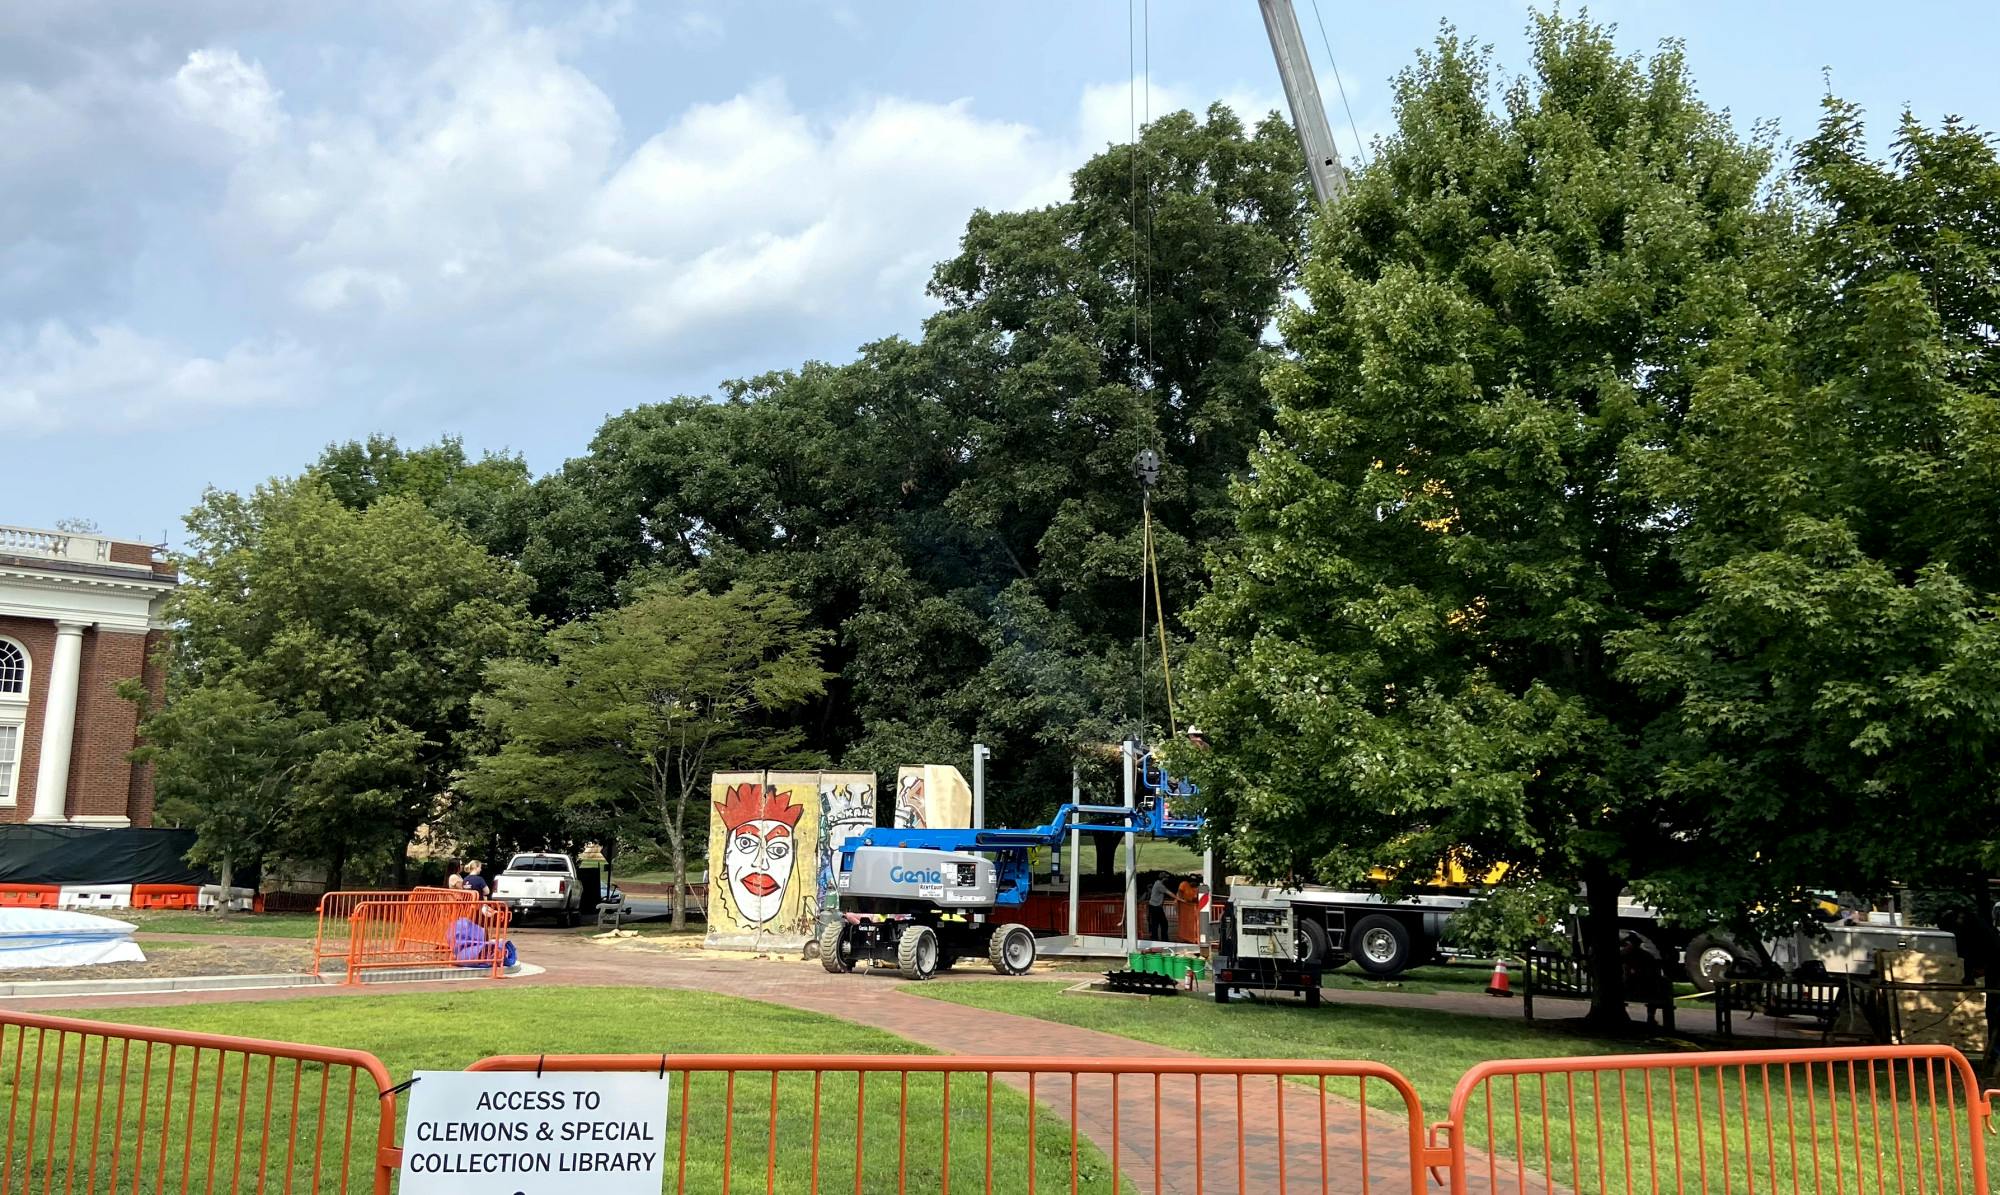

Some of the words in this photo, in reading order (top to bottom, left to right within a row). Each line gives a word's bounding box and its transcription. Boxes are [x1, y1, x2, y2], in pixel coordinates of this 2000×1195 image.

[890, 866, 941, 883] Genie
[476, 1091, 565, 1110] ACCESS
[573, 1091, 600, 1110] TO
[417, 1122, 528, 1141] CLEMONS
[536, 1122, 553, 1141] &
[560, 1121, 654, 1141] SPECIAL
[410, 1153, 550, 1172] COLLECTION
[559, 1153, 656, 1172] LIBRARY
